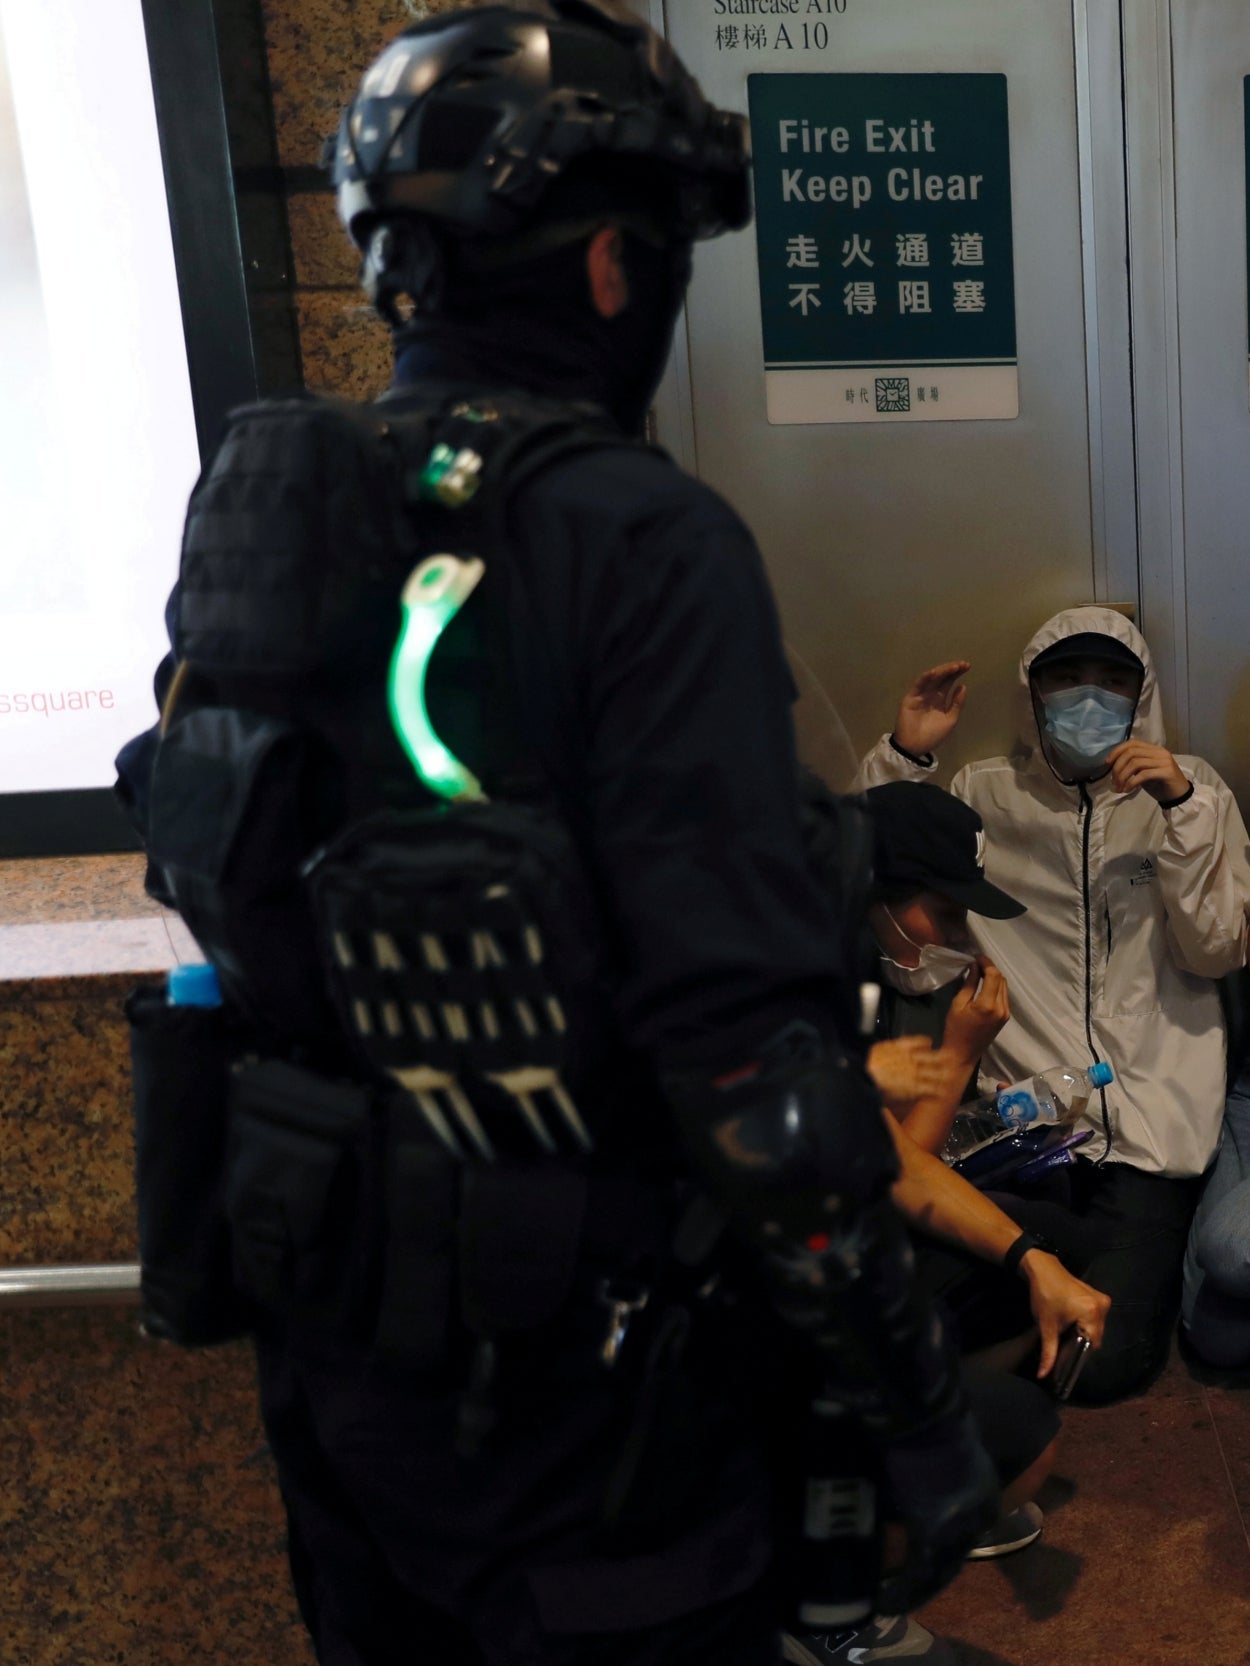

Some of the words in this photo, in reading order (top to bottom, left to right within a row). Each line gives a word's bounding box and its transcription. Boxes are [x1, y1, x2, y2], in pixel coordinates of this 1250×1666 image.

[715, 24, 767, 51] 樓梯
[779, 119, 850, 152] Fire
[865, 119, 936, 152] Exit
[781, 169, 872, 208] Keep
[887, 168, 983, 201] Clear
[786, 233, 985, 268] 走火通道
[788, 279, 986, 316] 不得阻塞
